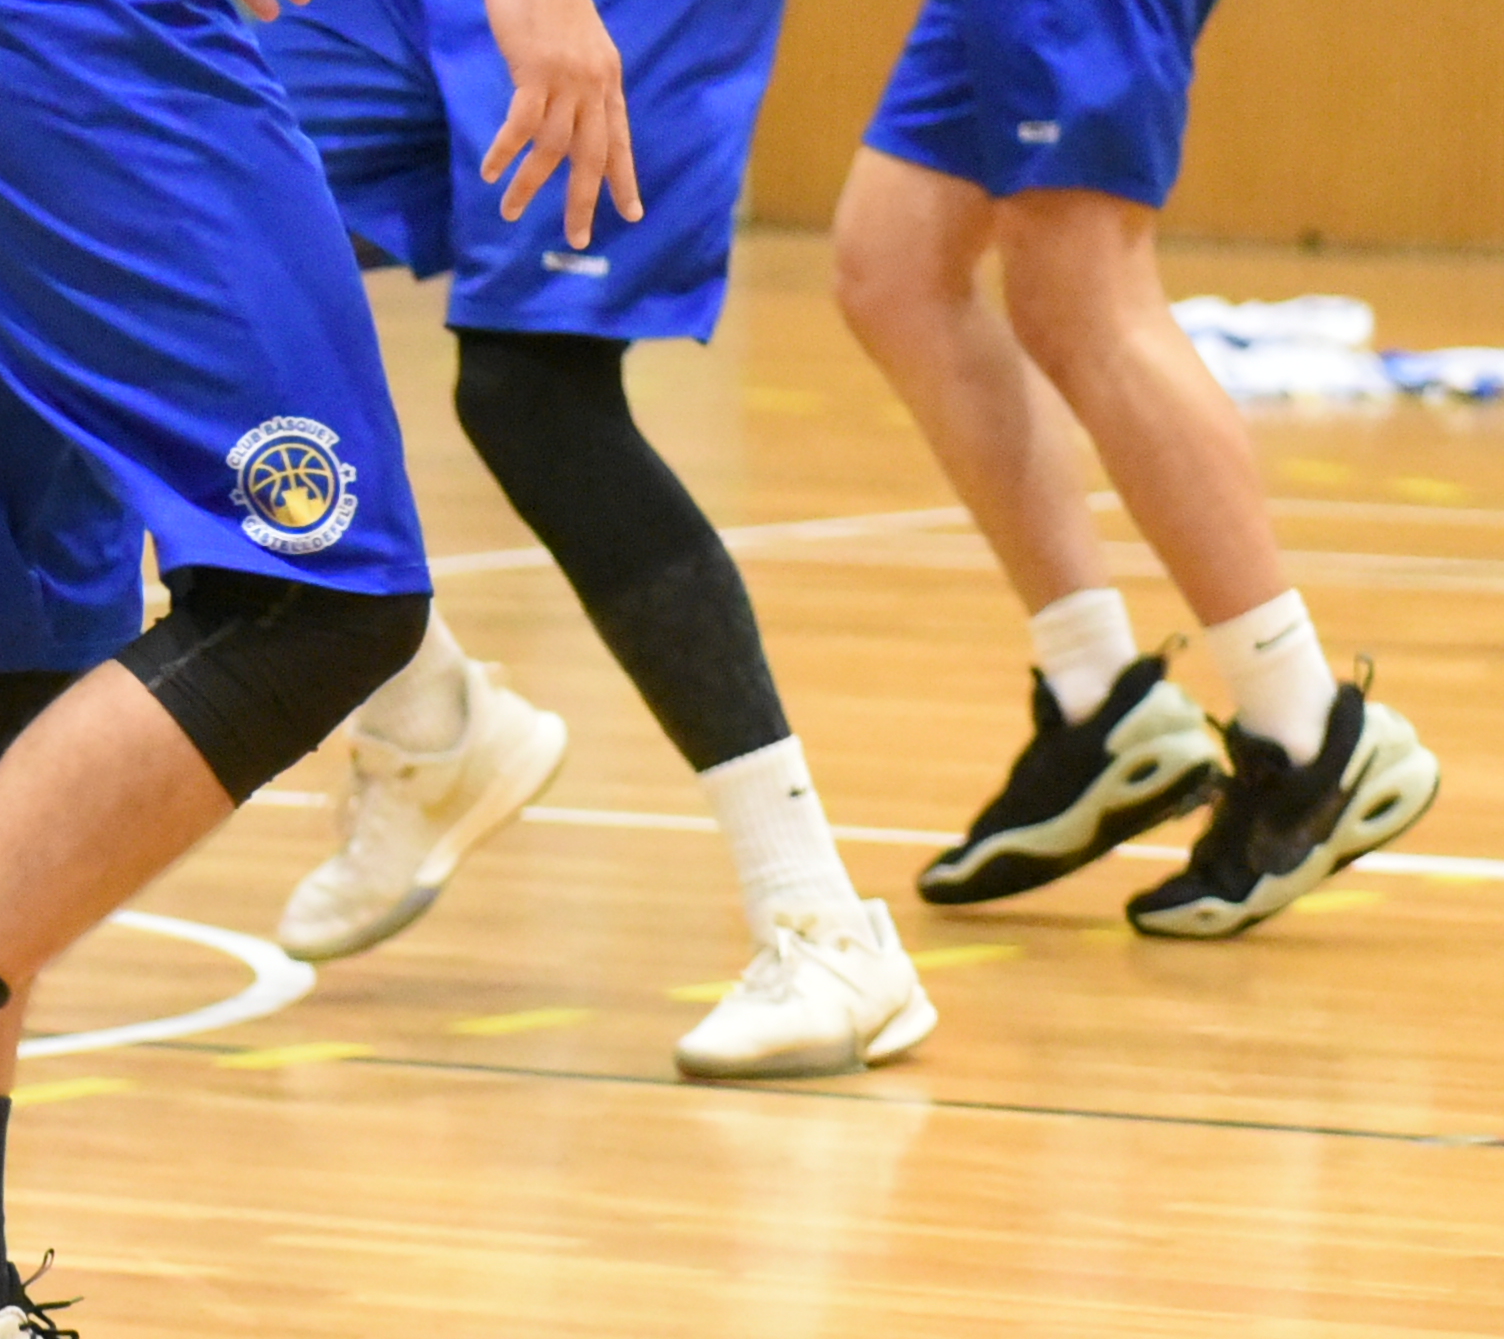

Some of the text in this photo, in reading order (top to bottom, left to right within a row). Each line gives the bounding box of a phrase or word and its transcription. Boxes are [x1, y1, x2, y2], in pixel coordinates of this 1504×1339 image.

[228, 417, 337, 468] CLUB BASQUET
[244, 496, 355, 553] CASTELLDEFELS
